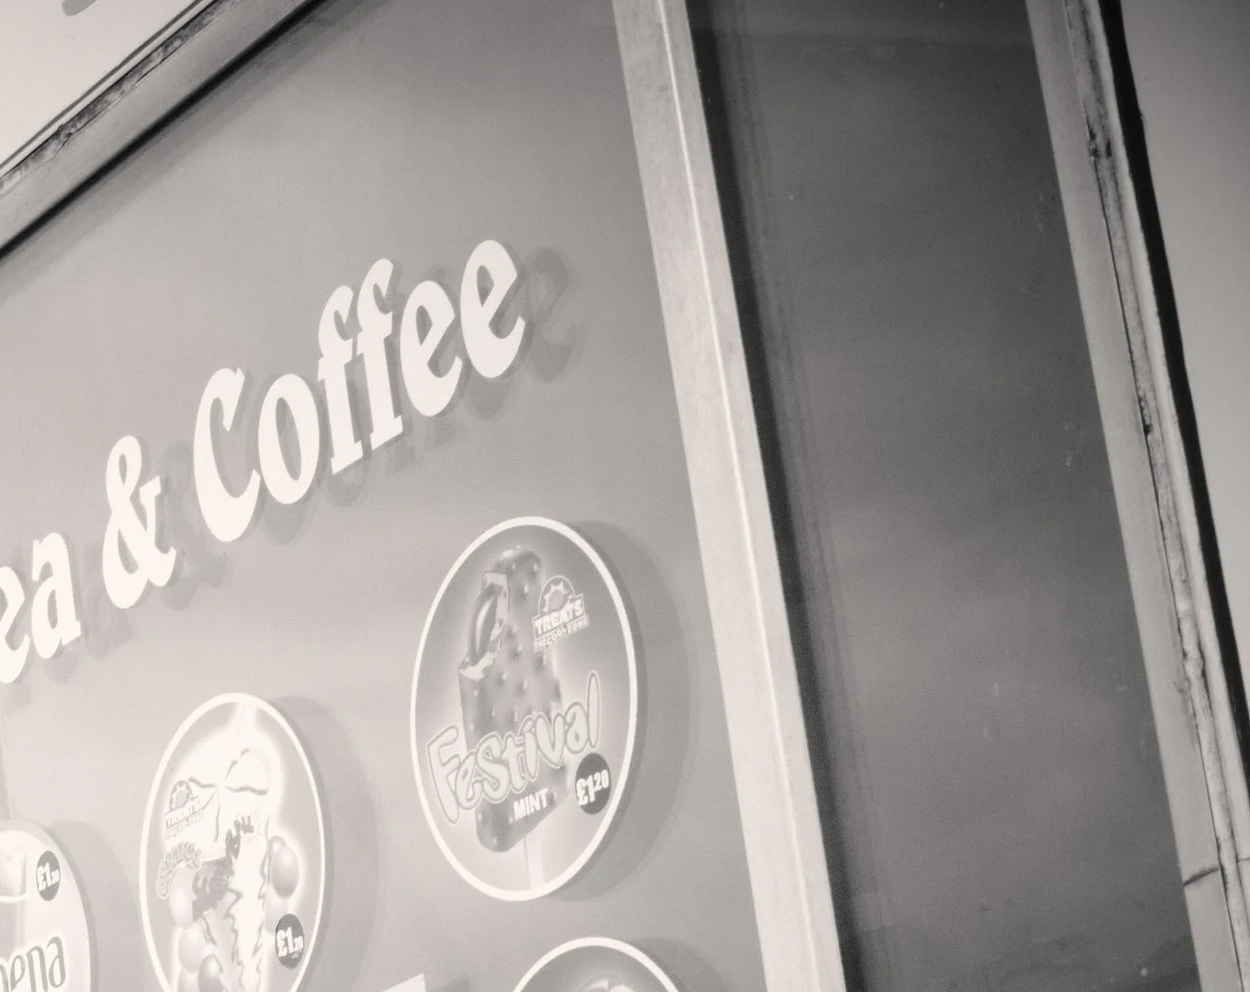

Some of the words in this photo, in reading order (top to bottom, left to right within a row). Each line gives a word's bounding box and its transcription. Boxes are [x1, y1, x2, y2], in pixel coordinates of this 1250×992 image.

[102, 435, 176, 609] &
[193, 240, 526, 543] Coffee
[426, 671, 600, 823] Festival
[514, 788, 549, 820] MINT
